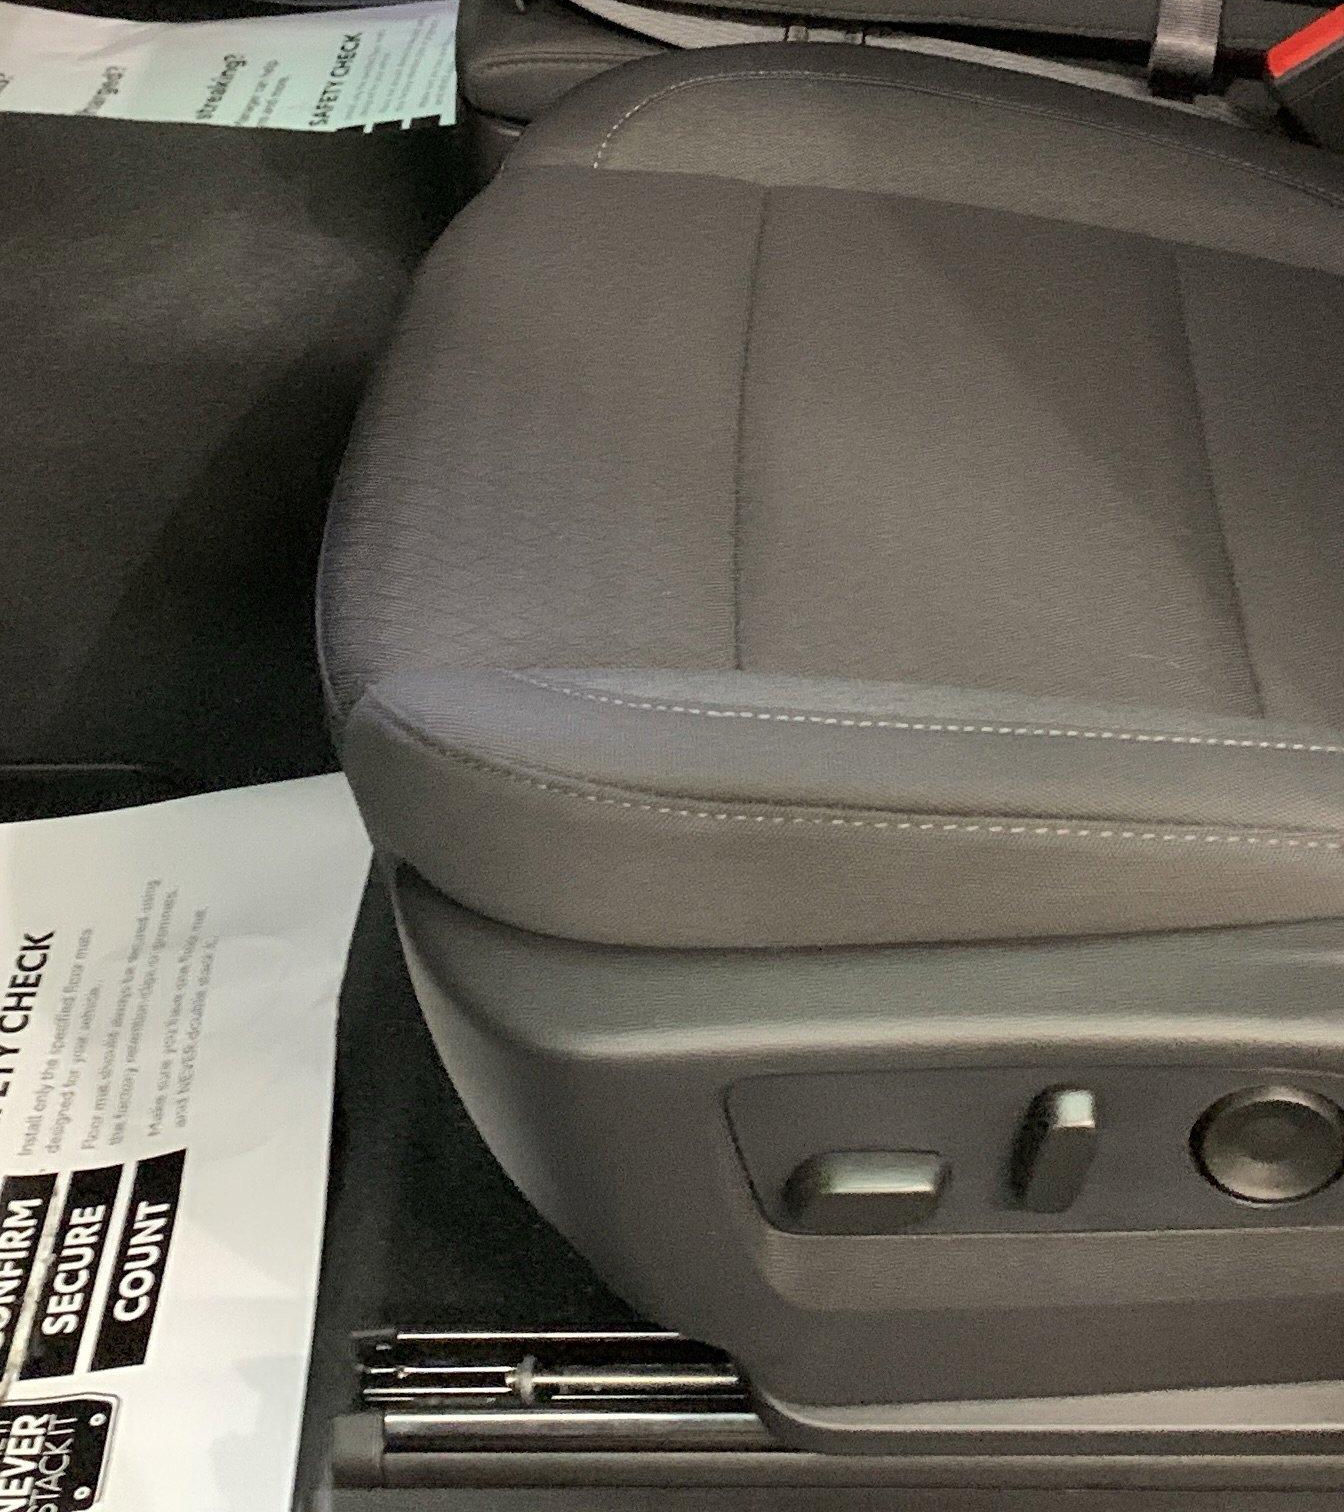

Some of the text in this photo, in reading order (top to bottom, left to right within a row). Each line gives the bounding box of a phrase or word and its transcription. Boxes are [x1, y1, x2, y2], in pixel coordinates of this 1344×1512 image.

[195, 53, 248, 119] streaking?
[308, 31, 363, 126] SAFETY CHECK
[35, 1084, 55, 1112] only
[41, 1059, 59, 1080] the
[17, 1115, 42, 1156] Install
[45, 1090, 75, 1154] designed
[41, 1204, 106, 1336] SECURE
[112, 1200, 170, 1322] COUNT
[25, 1414, 78, 1512] STACK IT
